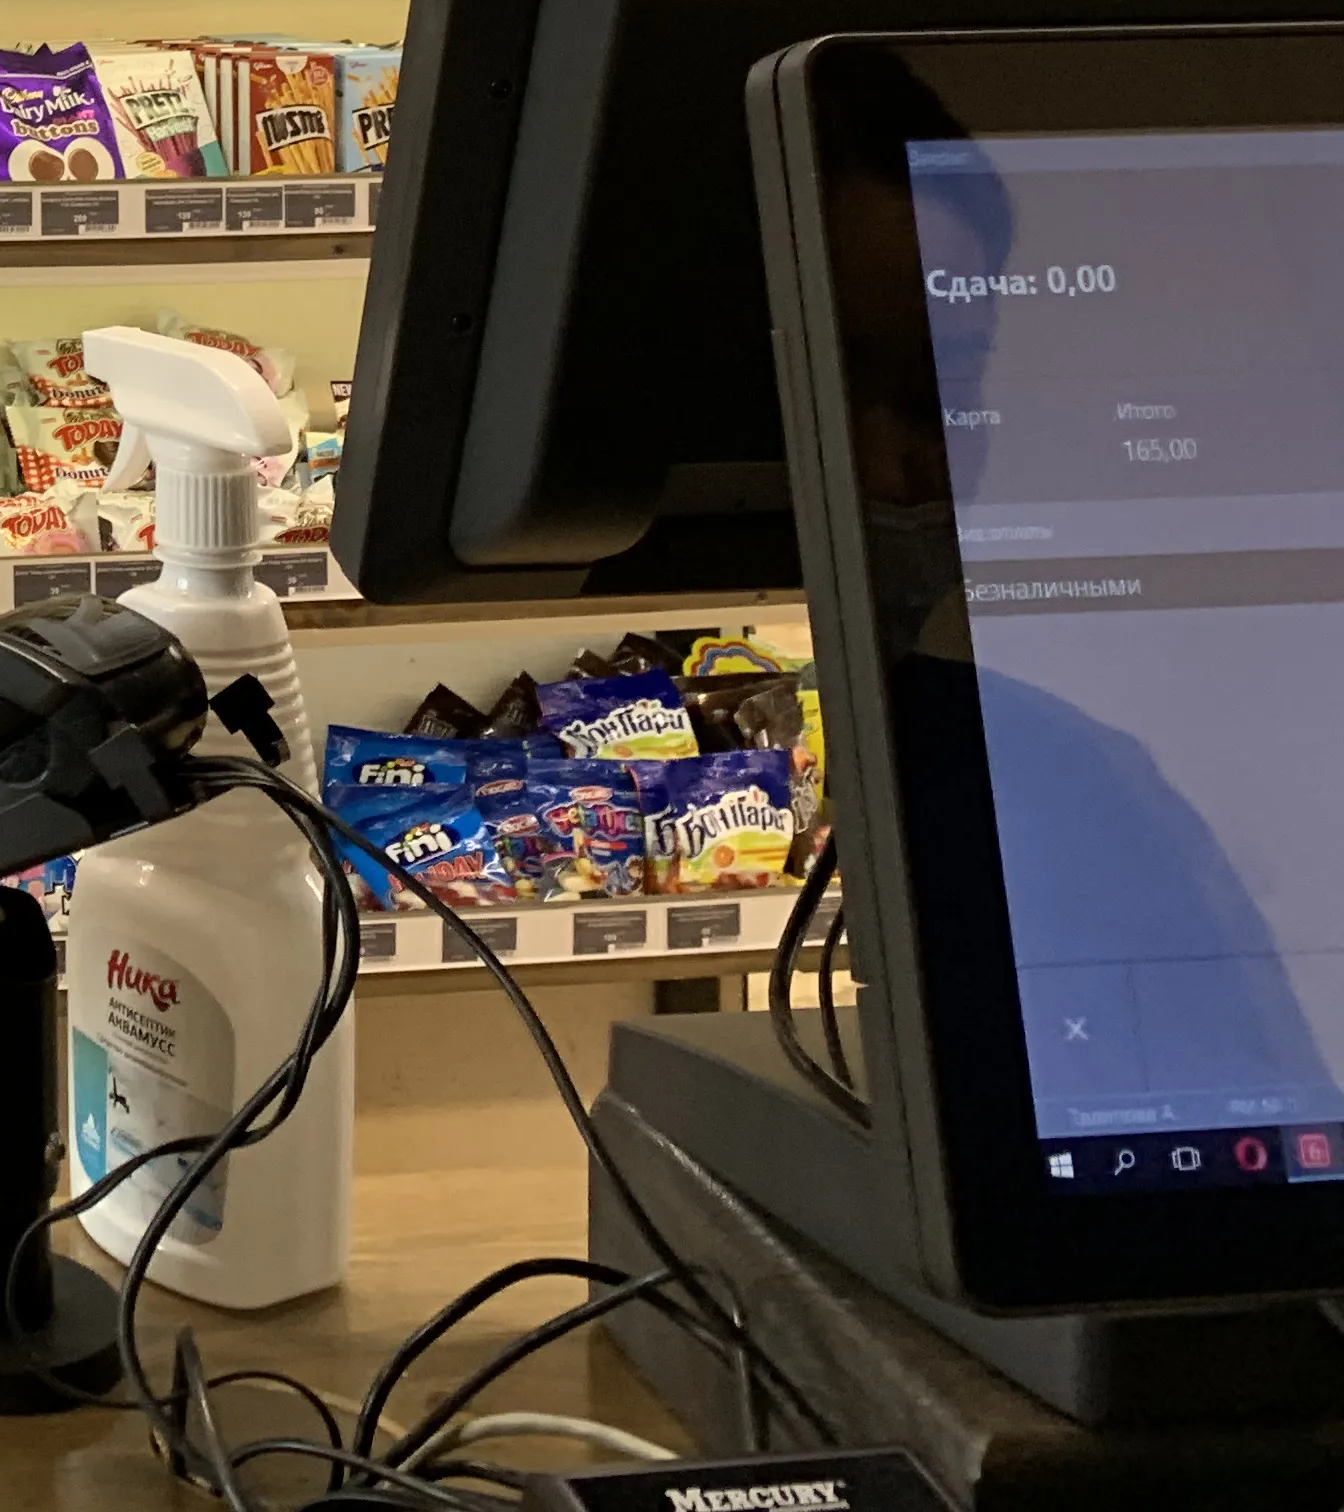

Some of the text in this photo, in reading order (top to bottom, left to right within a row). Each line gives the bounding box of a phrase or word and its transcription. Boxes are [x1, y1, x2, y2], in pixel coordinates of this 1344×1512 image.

[0, 95, 44, 123] Dairy
[10, 119, 100, 141] buttons
[926, 264, 1116, 304] Сдача: 0,00
[944, 407, 1002, 431] Карта
[1116, 402, 1177, 422] Итого
[1122, 437, 1198, 464] 165,00
[359, 763, 427, 786] Fini
[385, 823, 453, 865] Fini
[107, 949, 181, 1013] Ника
[107, 1011, 177, 1058] АКВАМУСС
